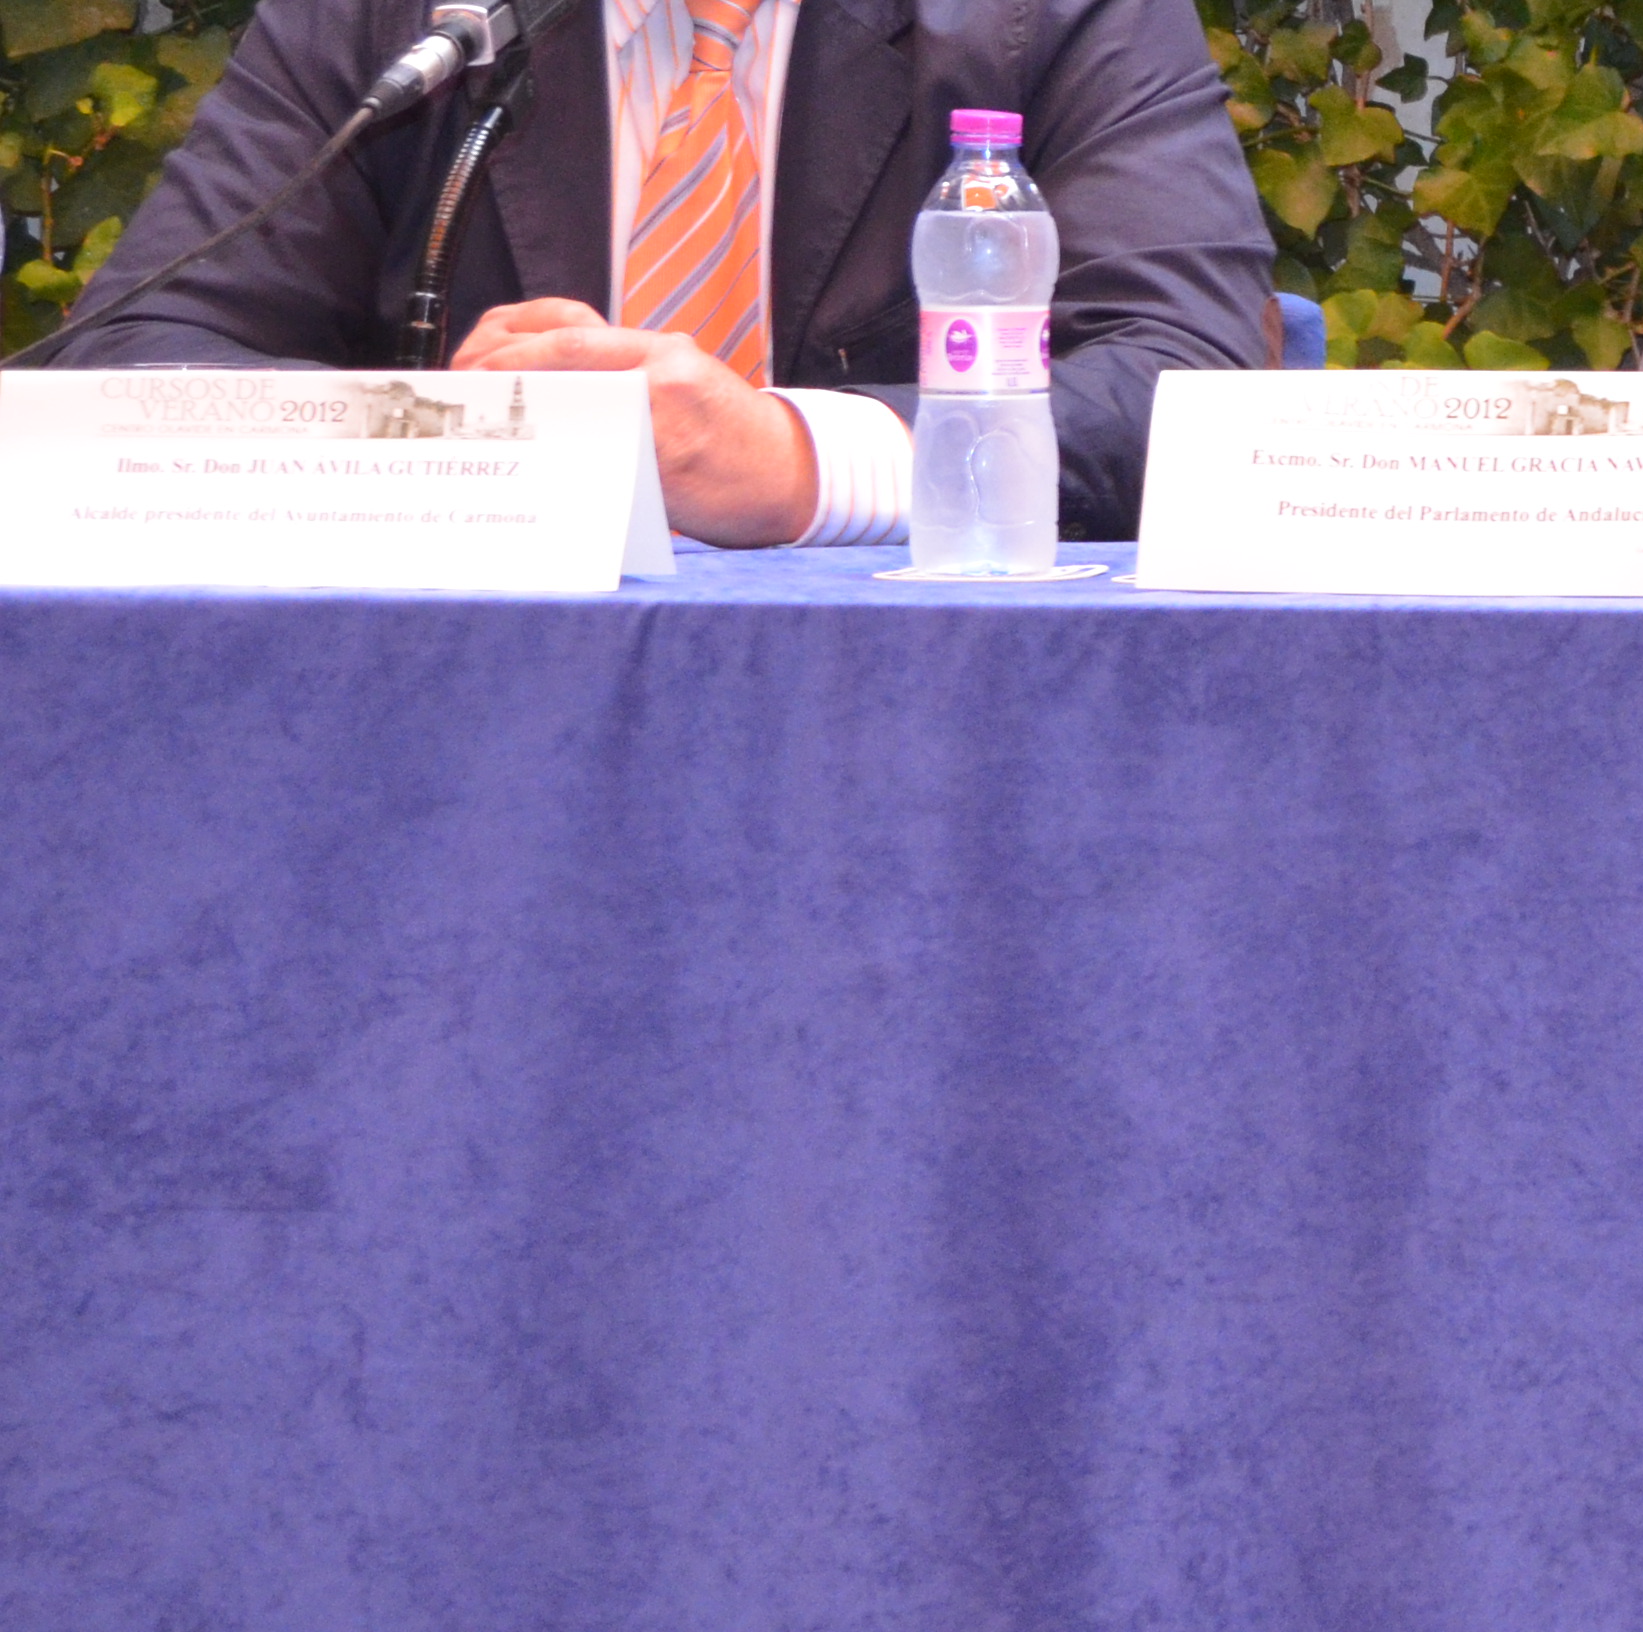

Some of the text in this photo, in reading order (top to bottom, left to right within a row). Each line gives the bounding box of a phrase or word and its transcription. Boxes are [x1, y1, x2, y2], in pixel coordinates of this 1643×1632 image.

[100, 378, 277, 401] CURSOS DE
[1400, 375, 1440, 398] DE
[138, 399, 349, 423] VERANO 2012
[1443, 396, 1513, 420] 2012
[217, 424, 235, 435] EN
[117, 457, 165, 474] Ilmo.
[171, 458, 197, 474] Sr.
[203, 458, 242, 475] Don
[247, 458, 305, 475] JUAN
[1251, 448, 1322, 467] Excmo.
[1329, 452, 1354, 469] Sr.
[1362, 453, 1401, 470] Don
[1408, 455, 1505, 473] MANUEL
[1510, 456, 1600, 473] GRACIA
[71, 506, 538, 524] Alcalde presidente del Ayuntamiento de Carmona
[1277, 500, 1379, 520] Presidente
[1384, 505, 1413, 521] del
[1419, 505, 1530, 522] Parlamento
[1535, 506, 1558, 523] de
